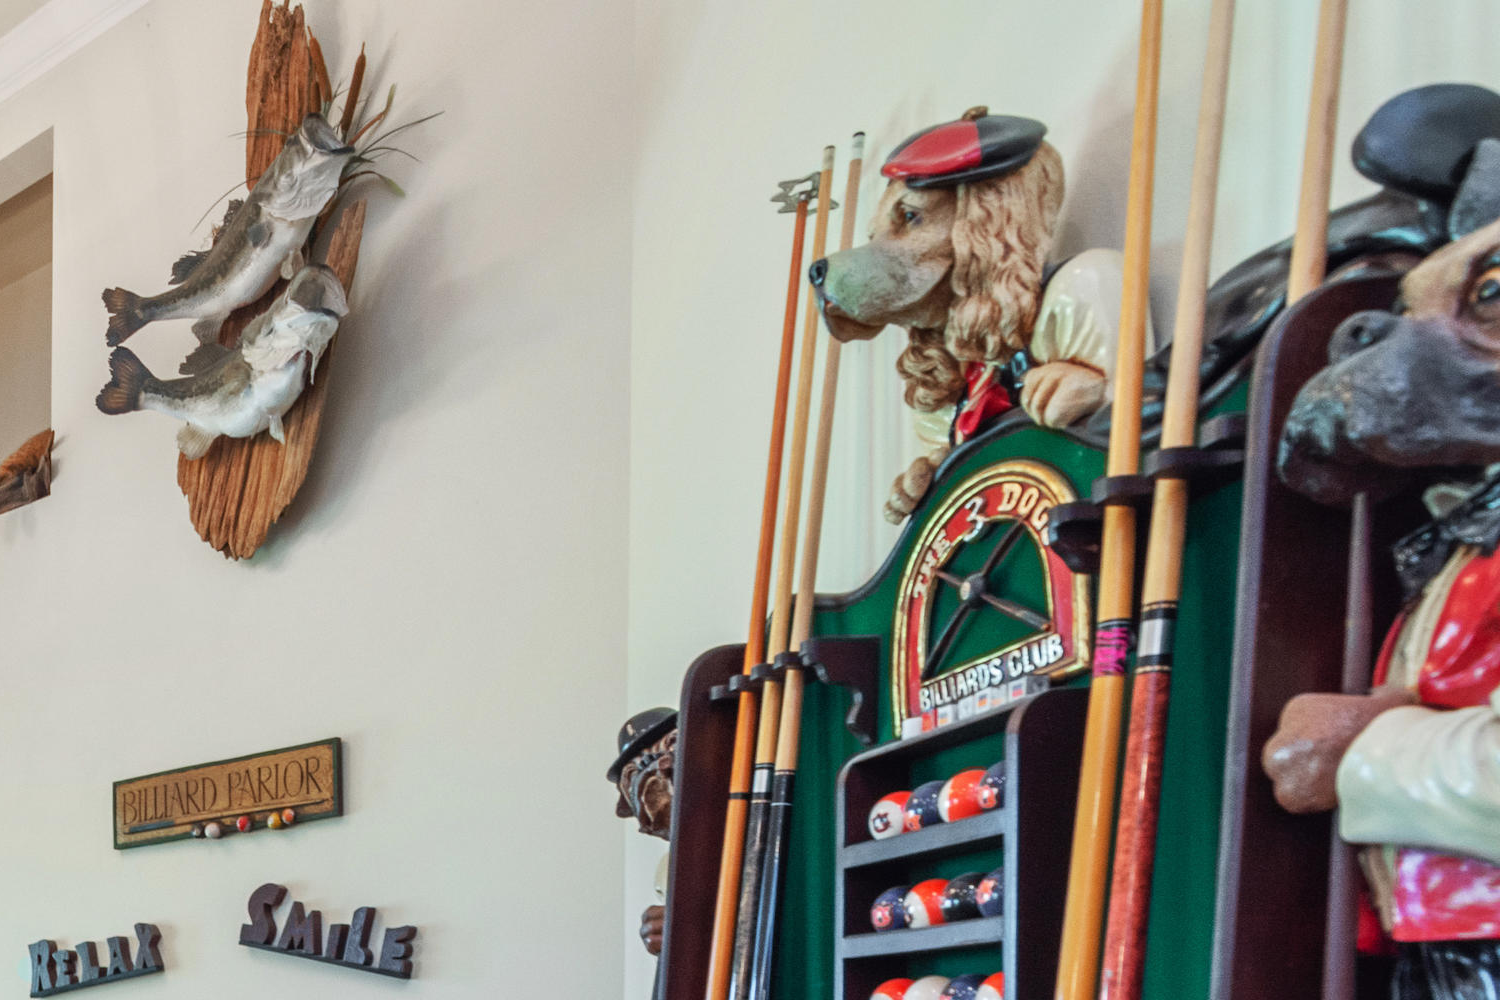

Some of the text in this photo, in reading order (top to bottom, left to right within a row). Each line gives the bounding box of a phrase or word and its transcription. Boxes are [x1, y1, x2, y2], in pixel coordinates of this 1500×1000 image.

[963, 496, 987, 542] 3
[920, 633, 1064, 711] BILLIARDS CLUB
[122, 756, 323, 826] BILLIARD PARLOR
[28, 922, 164, 997] RELAX
[239, 882, 419, 979] SMILE
